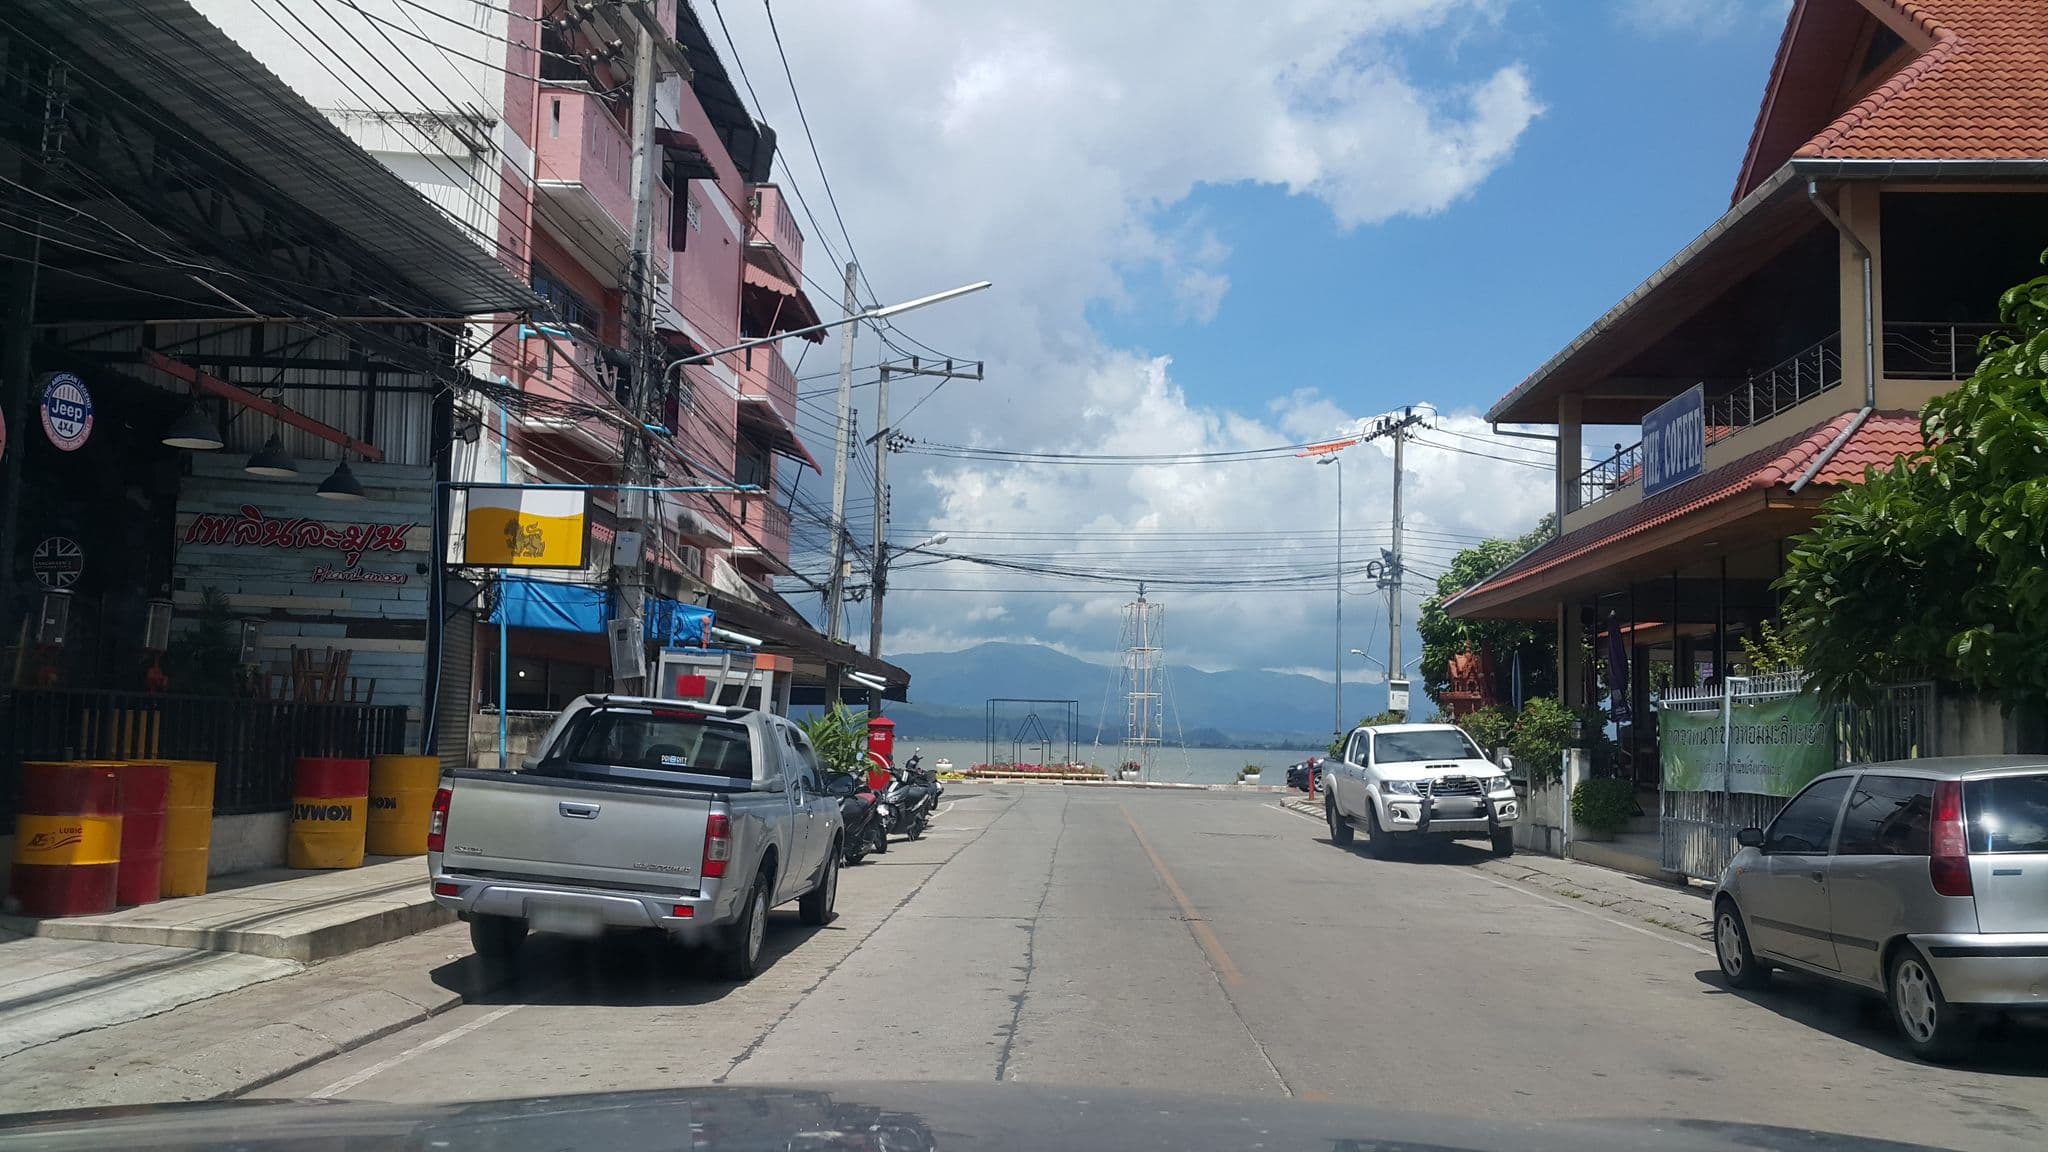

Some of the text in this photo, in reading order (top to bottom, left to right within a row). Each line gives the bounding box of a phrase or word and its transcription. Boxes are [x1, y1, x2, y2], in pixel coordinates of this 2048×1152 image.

[51, 399, 83, 422] Jeep
[1644, 407, 1701, 489] THE COFFEE
[184, 504, 416, 567] เพลินละมุน
